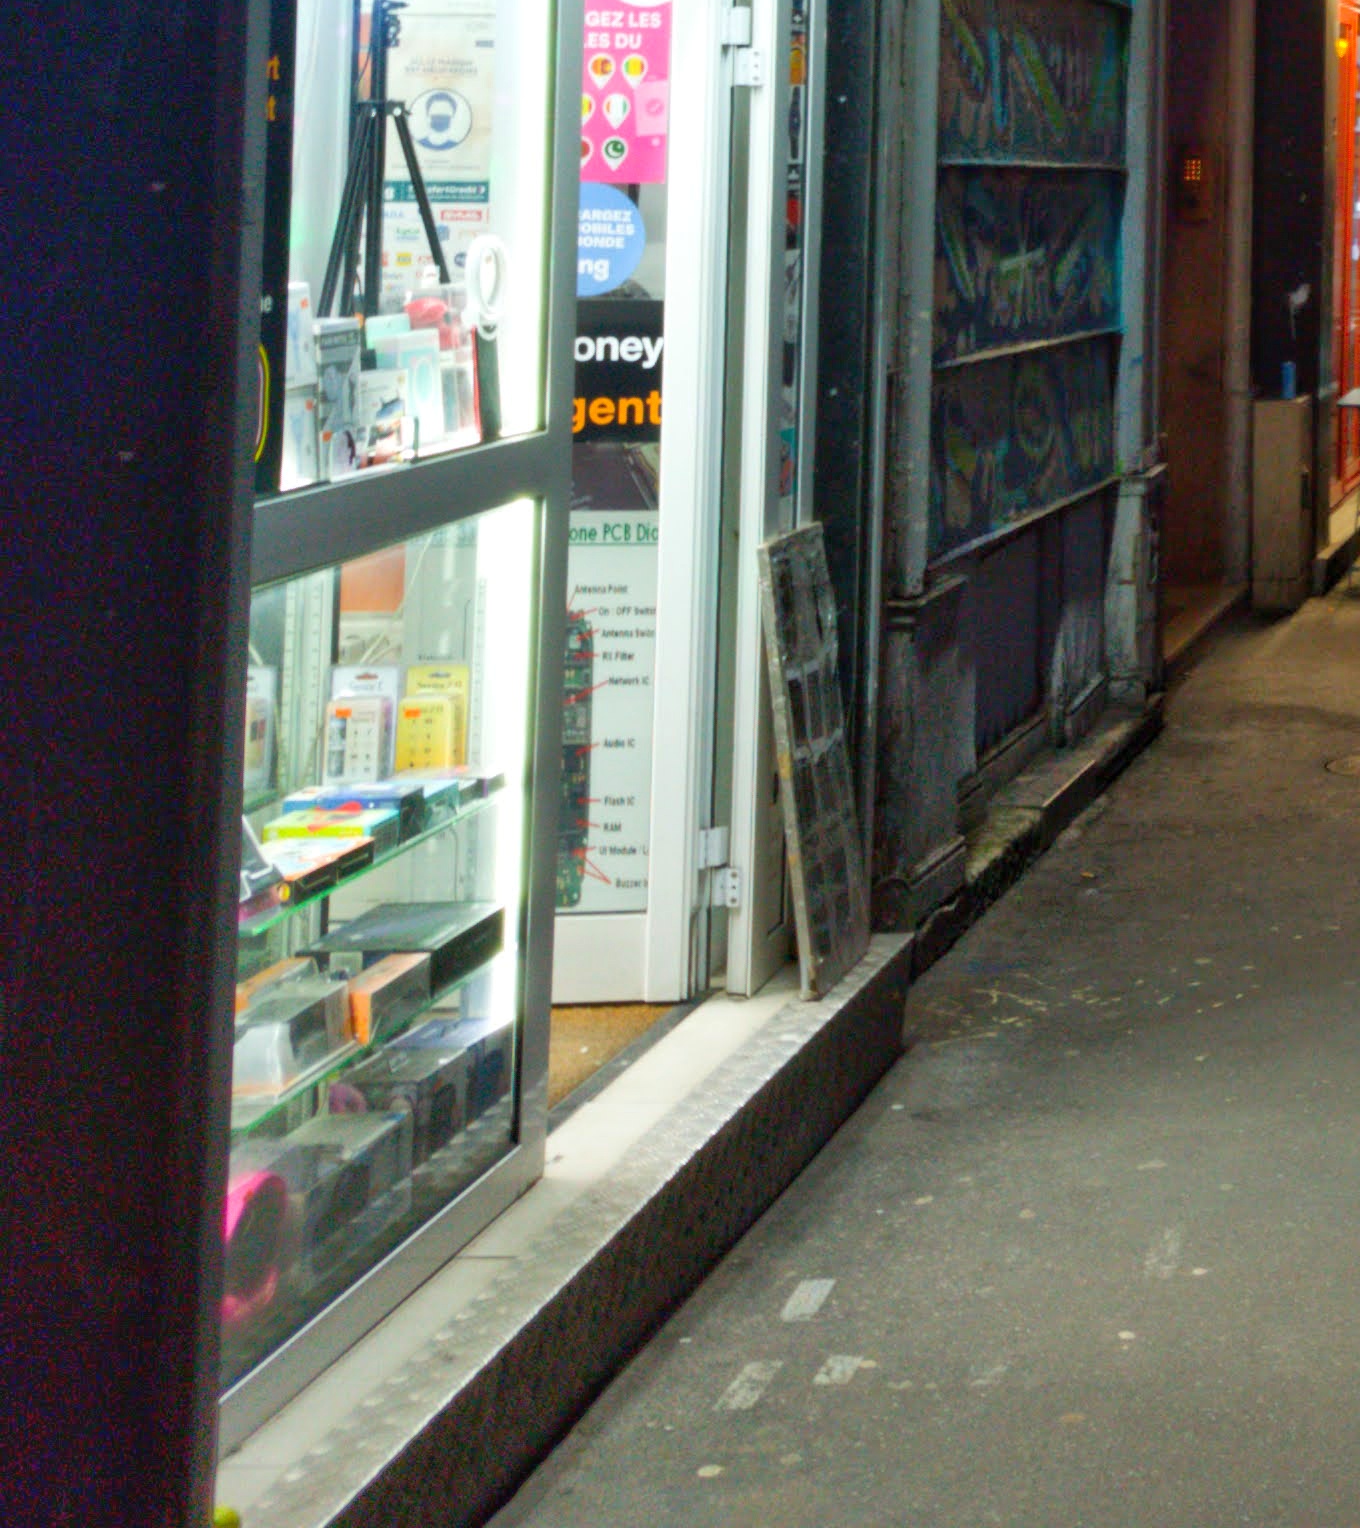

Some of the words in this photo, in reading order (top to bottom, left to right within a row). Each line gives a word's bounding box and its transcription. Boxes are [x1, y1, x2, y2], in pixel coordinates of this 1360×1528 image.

[627, 12, 662, 29] LES
[584, 32, 610, 49] ES
[614, 33, 642, 49] DU
[602, 524, 631, 542] PCB
